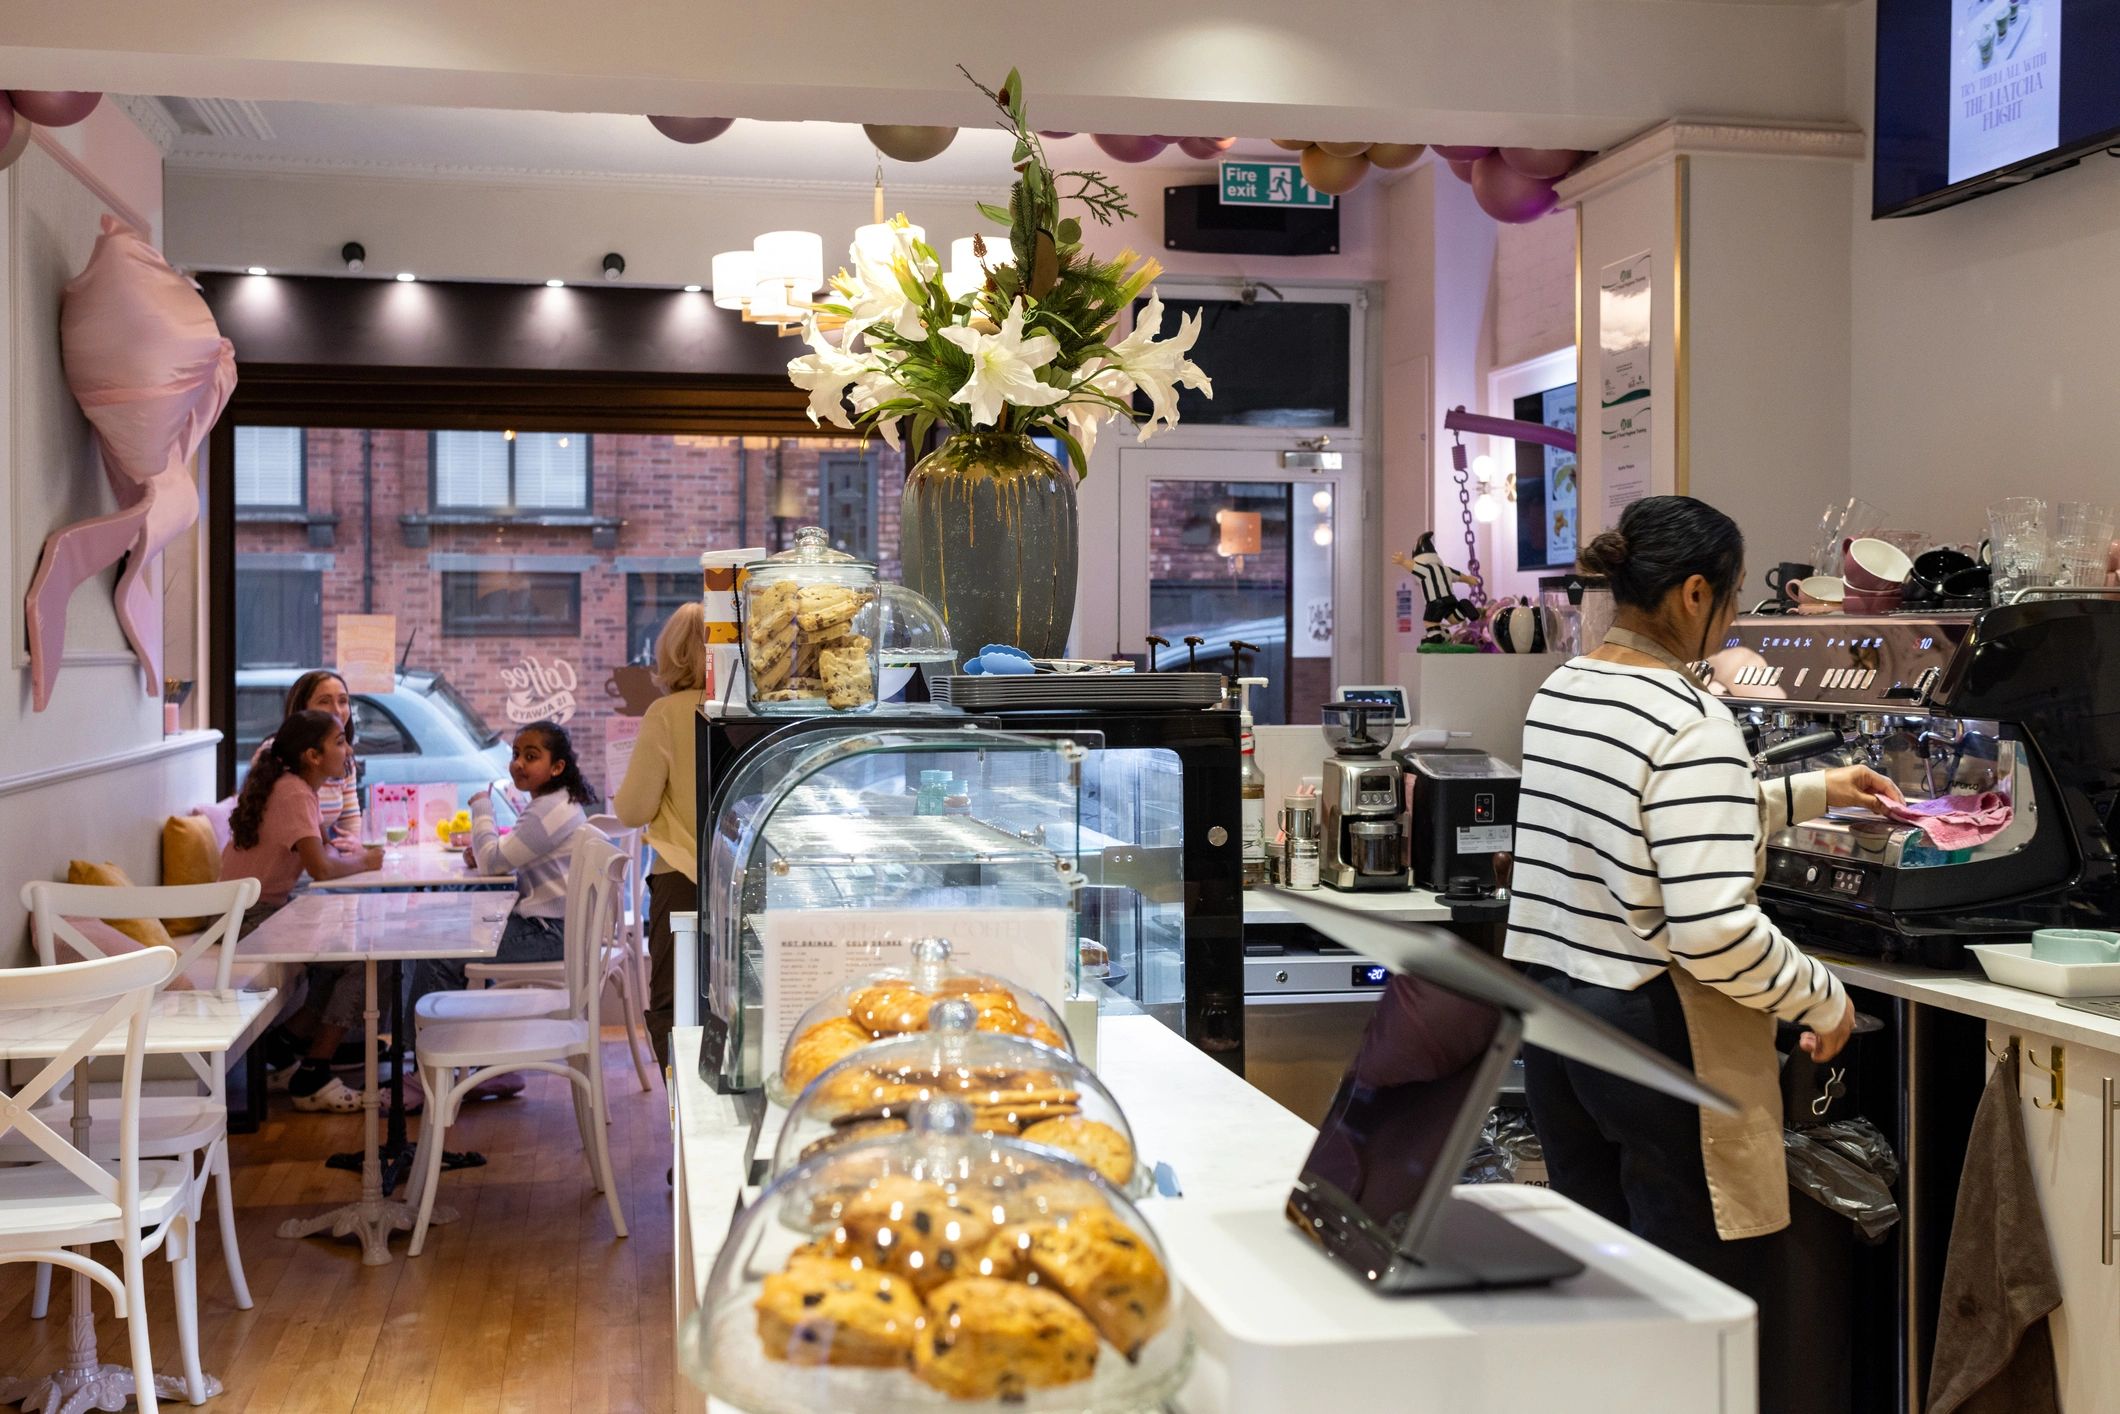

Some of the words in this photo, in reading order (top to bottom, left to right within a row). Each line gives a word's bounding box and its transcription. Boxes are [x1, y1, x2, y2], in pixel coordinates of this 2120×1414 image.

[1964, 94, 1987, 119] THE
[1988, 71, 2043, 109] MATCHA
[1983, 99, 2023, 132] FLIGHT
[1226, 167, 1257, 182] Fire
[1227, 183, 1257, 198] exit
